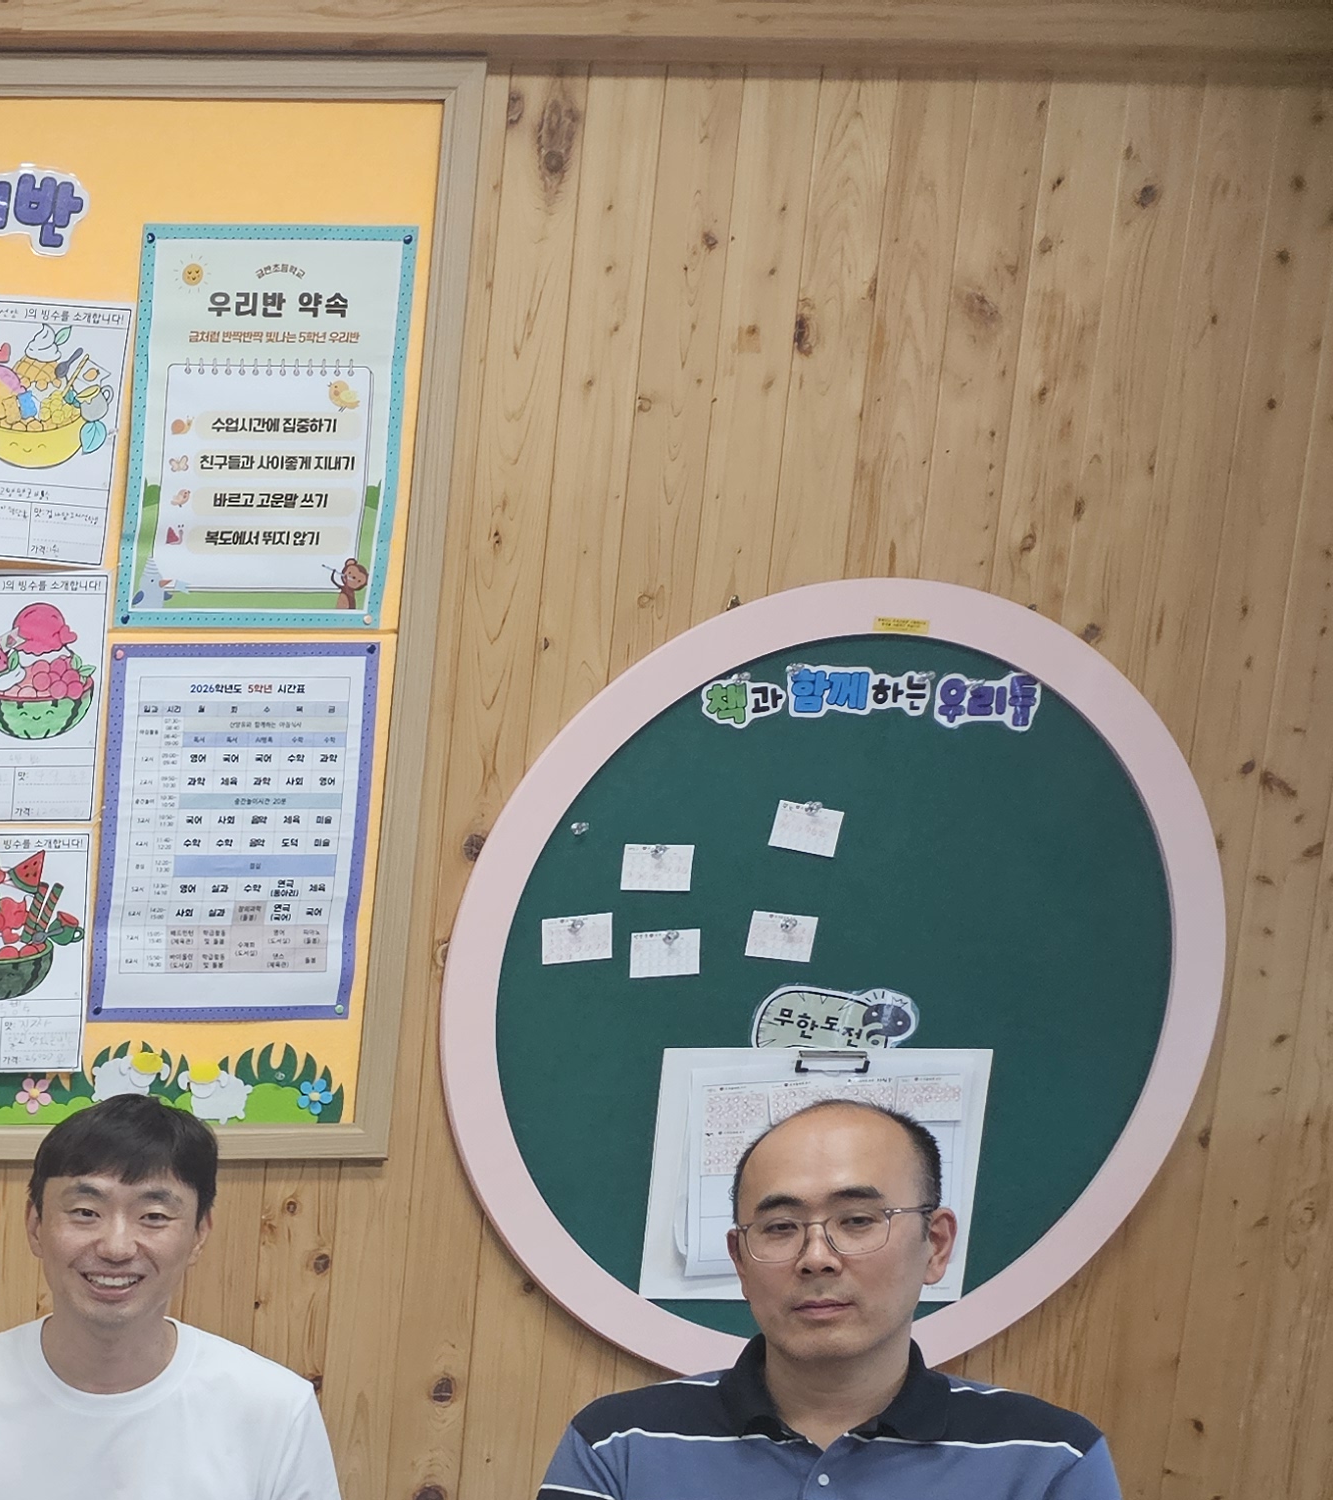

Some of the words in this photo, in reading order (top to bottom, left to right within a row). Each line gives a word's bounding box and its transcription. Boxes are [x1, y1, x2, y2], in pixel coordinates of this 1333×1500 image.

[207, 291, 286, 318] 우리반
[298, 292, 348, 318] 약속
[41, 309, 70, 322] 빙수를
[73, 310, 124, 326] 소개합니다!
[265, 331, 296, 343] 빛나는
[298, 331, 326, 344] 5학년
[328, 331, 360, 344] 우리반
[211, 417, 280, 433] 수업시간에
[282, 418, 337, 433] 집중하기
[200, 455, 254, 470] 친구들과
[257, 455, 311, 470] 사이좋게
[314, 456, 355, 471] 지내기
[213, 493, 254, 508] 바르고
[256, 493, 299, 509] 고운말
[300, 493, 328, 508] 쓰기
[205, 530, 259, 546] 복도에서
[262, 531, 290, 546] 뛰지
[293, 531, 320, 546] 않기
[18, 580, 46, 592] 빙수를
[50, 580, 101, 592] 소개합니다!
[190, 684, 242, 694] 2026학년도
[248, 684, 273, 694] 5학년
[278, 684, 305, 694] 시간표
[707, 683, 783, 724] 책과
[790, 668, 927, 715] 함께하는
[2, 838, 31, 850] 빙수를
[34, 838, 83, 850] 소개합니다!
[773, 1008, 863, 1048] 무한도전
